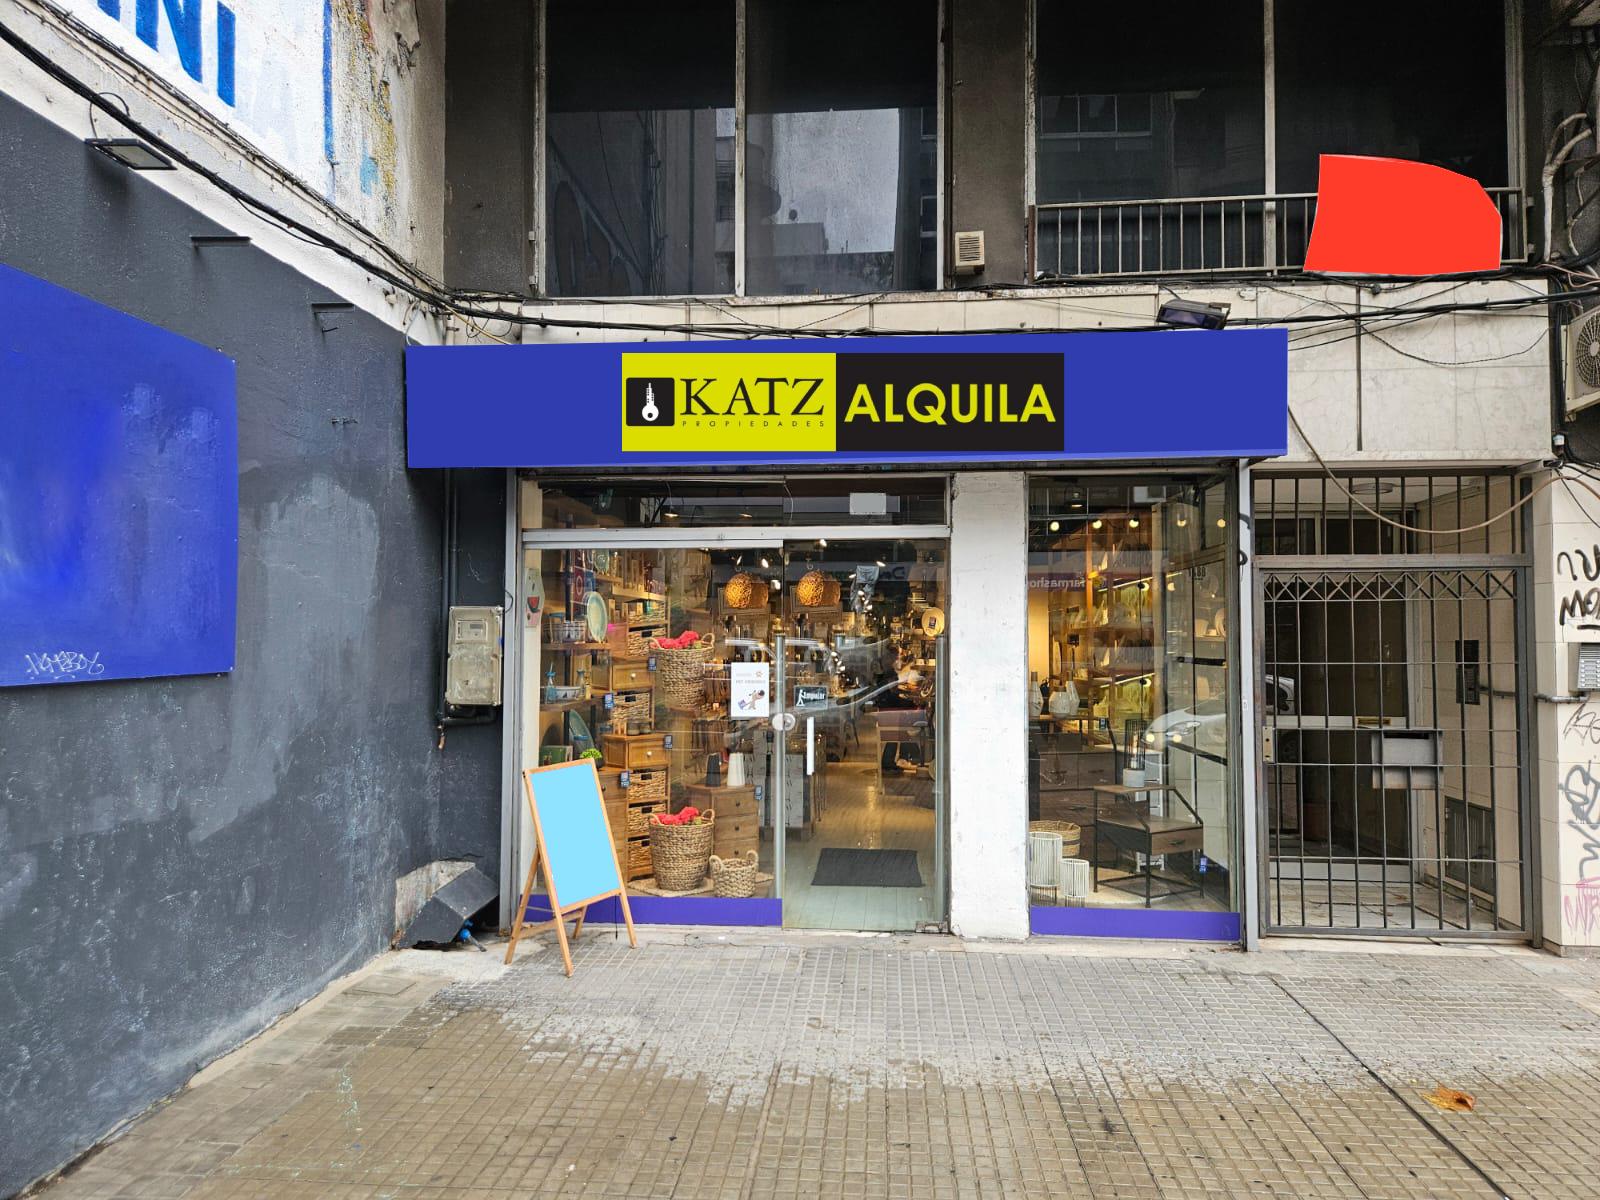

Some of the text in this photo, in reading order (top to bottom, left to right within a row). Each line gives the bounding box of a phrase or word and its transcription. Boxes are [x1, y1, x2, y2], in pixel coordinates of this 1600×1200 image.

[98, 0, 236, 108] NI
[680, 377, 1056, 425] KATZ ALQUILA
